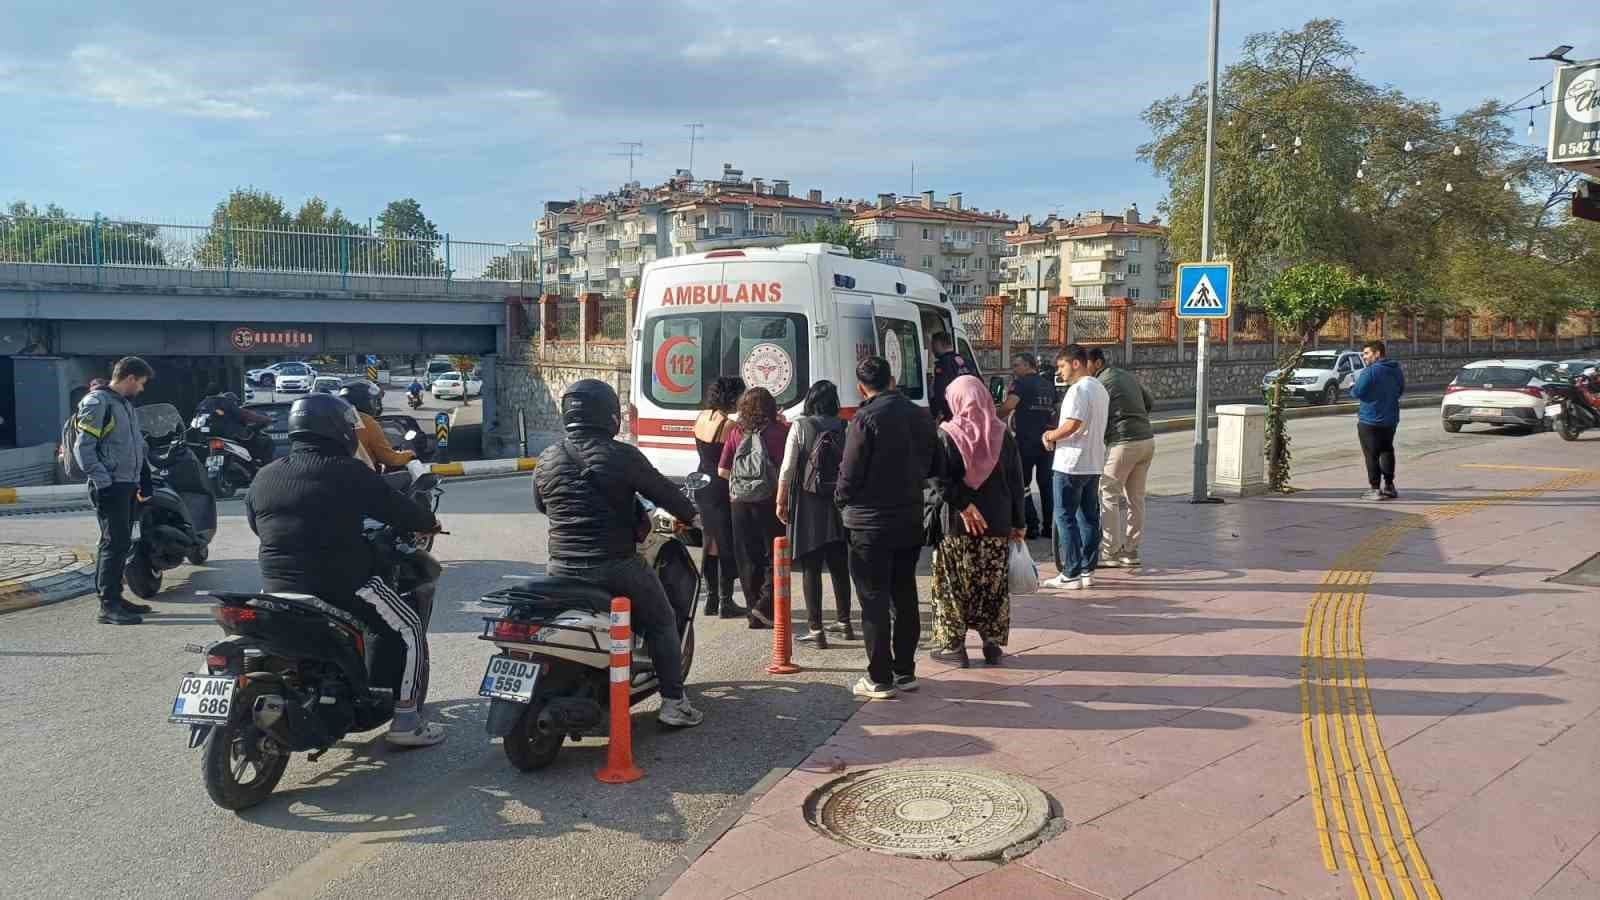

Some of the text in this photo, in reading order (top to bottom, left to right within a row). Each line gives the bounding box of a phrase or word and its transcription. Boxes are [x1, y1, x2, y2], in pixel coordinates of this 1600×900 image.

[1559, 143, 1567, 156] 0
[1568, 141, 1590, 155] 542
[662, 282, 782, 306] AMBULANS
[671, 354, 695, 376] 112
[182, 679, 233, 696] 09 ANF
[495, 676, 522, 693] 559
[198, 698, 229, 714] 686
